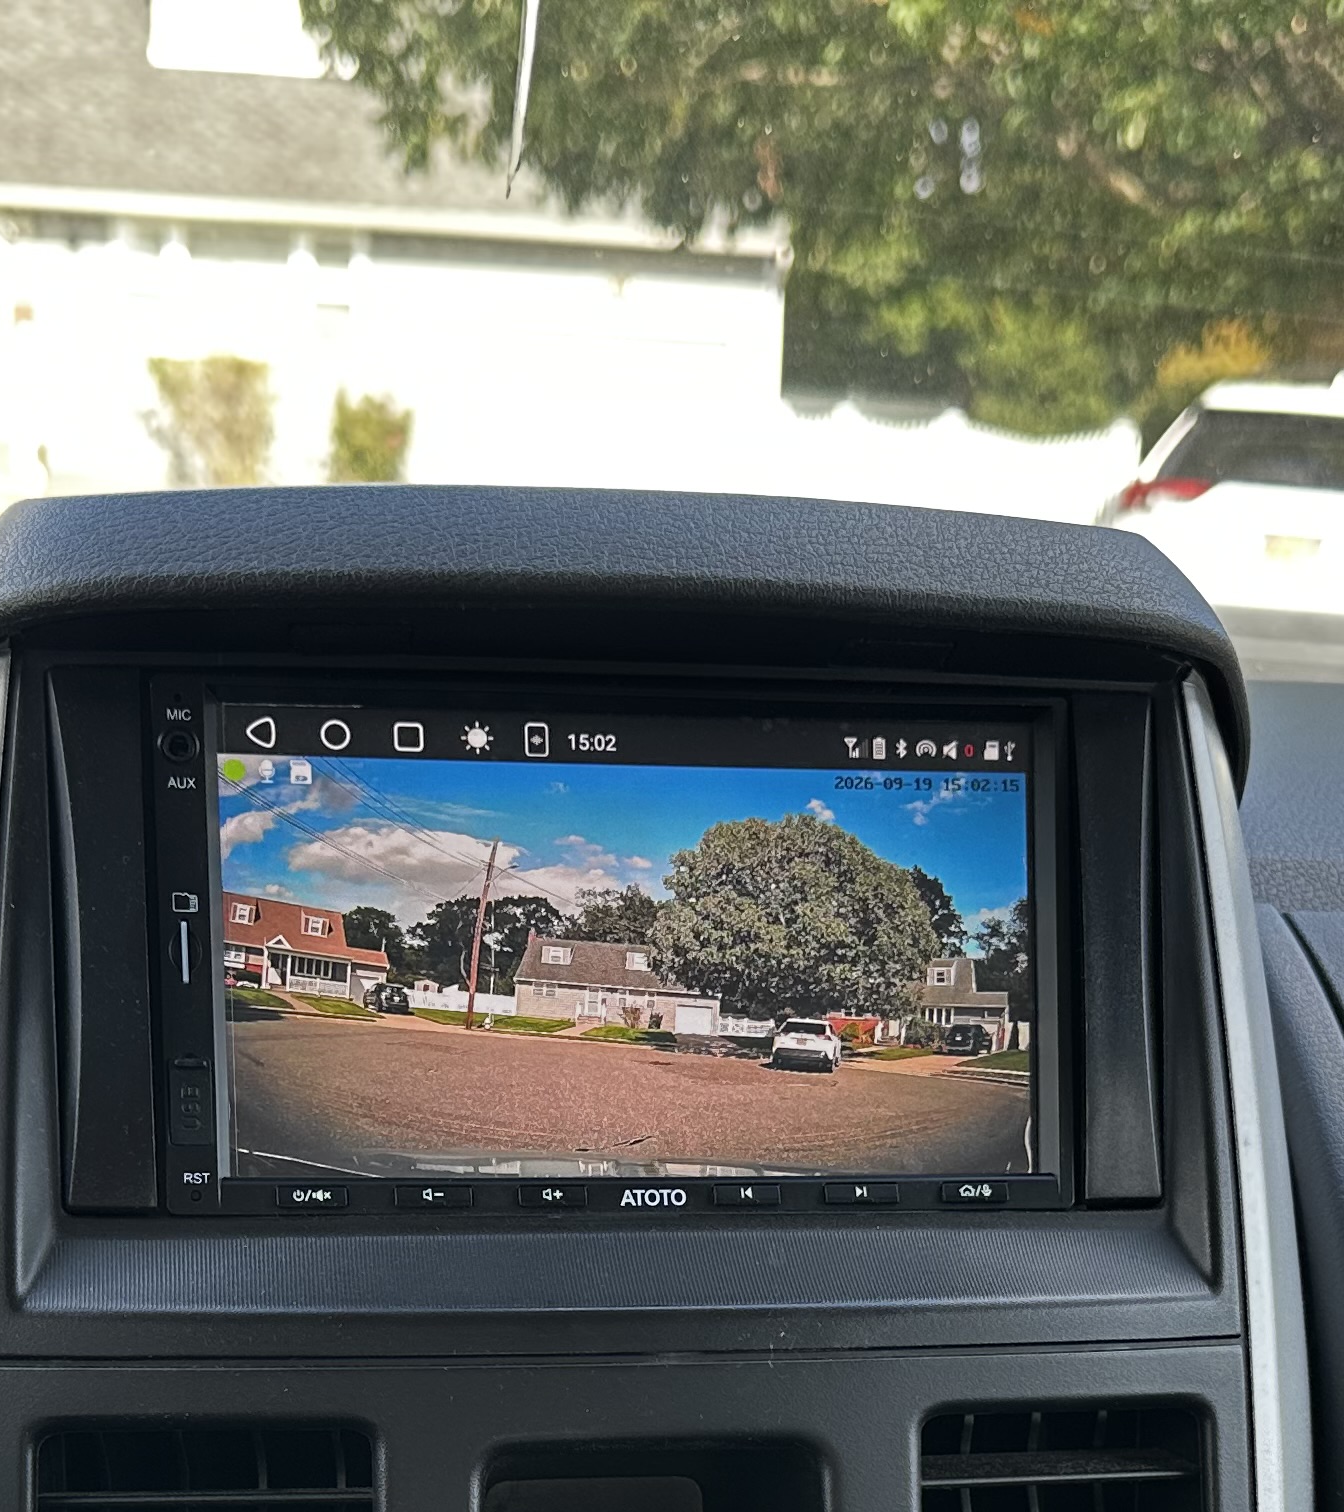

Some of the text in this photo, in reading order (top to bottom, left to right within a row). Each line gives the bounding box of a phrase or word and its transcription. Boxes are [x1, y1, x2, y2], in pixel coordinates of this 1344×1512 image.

[166, 707, 192, 721] MIC
[567, 734, 617, 752] 15:02
[167, 776, 197, 789] AUX
[834, 775, 1020, 793] 2026-09-19 15:02:15
[180, 1084, 202, 1131] USB
[182, 1172, 211, 1184] RST
[619, 1188, 687, 1207] ATOTO
